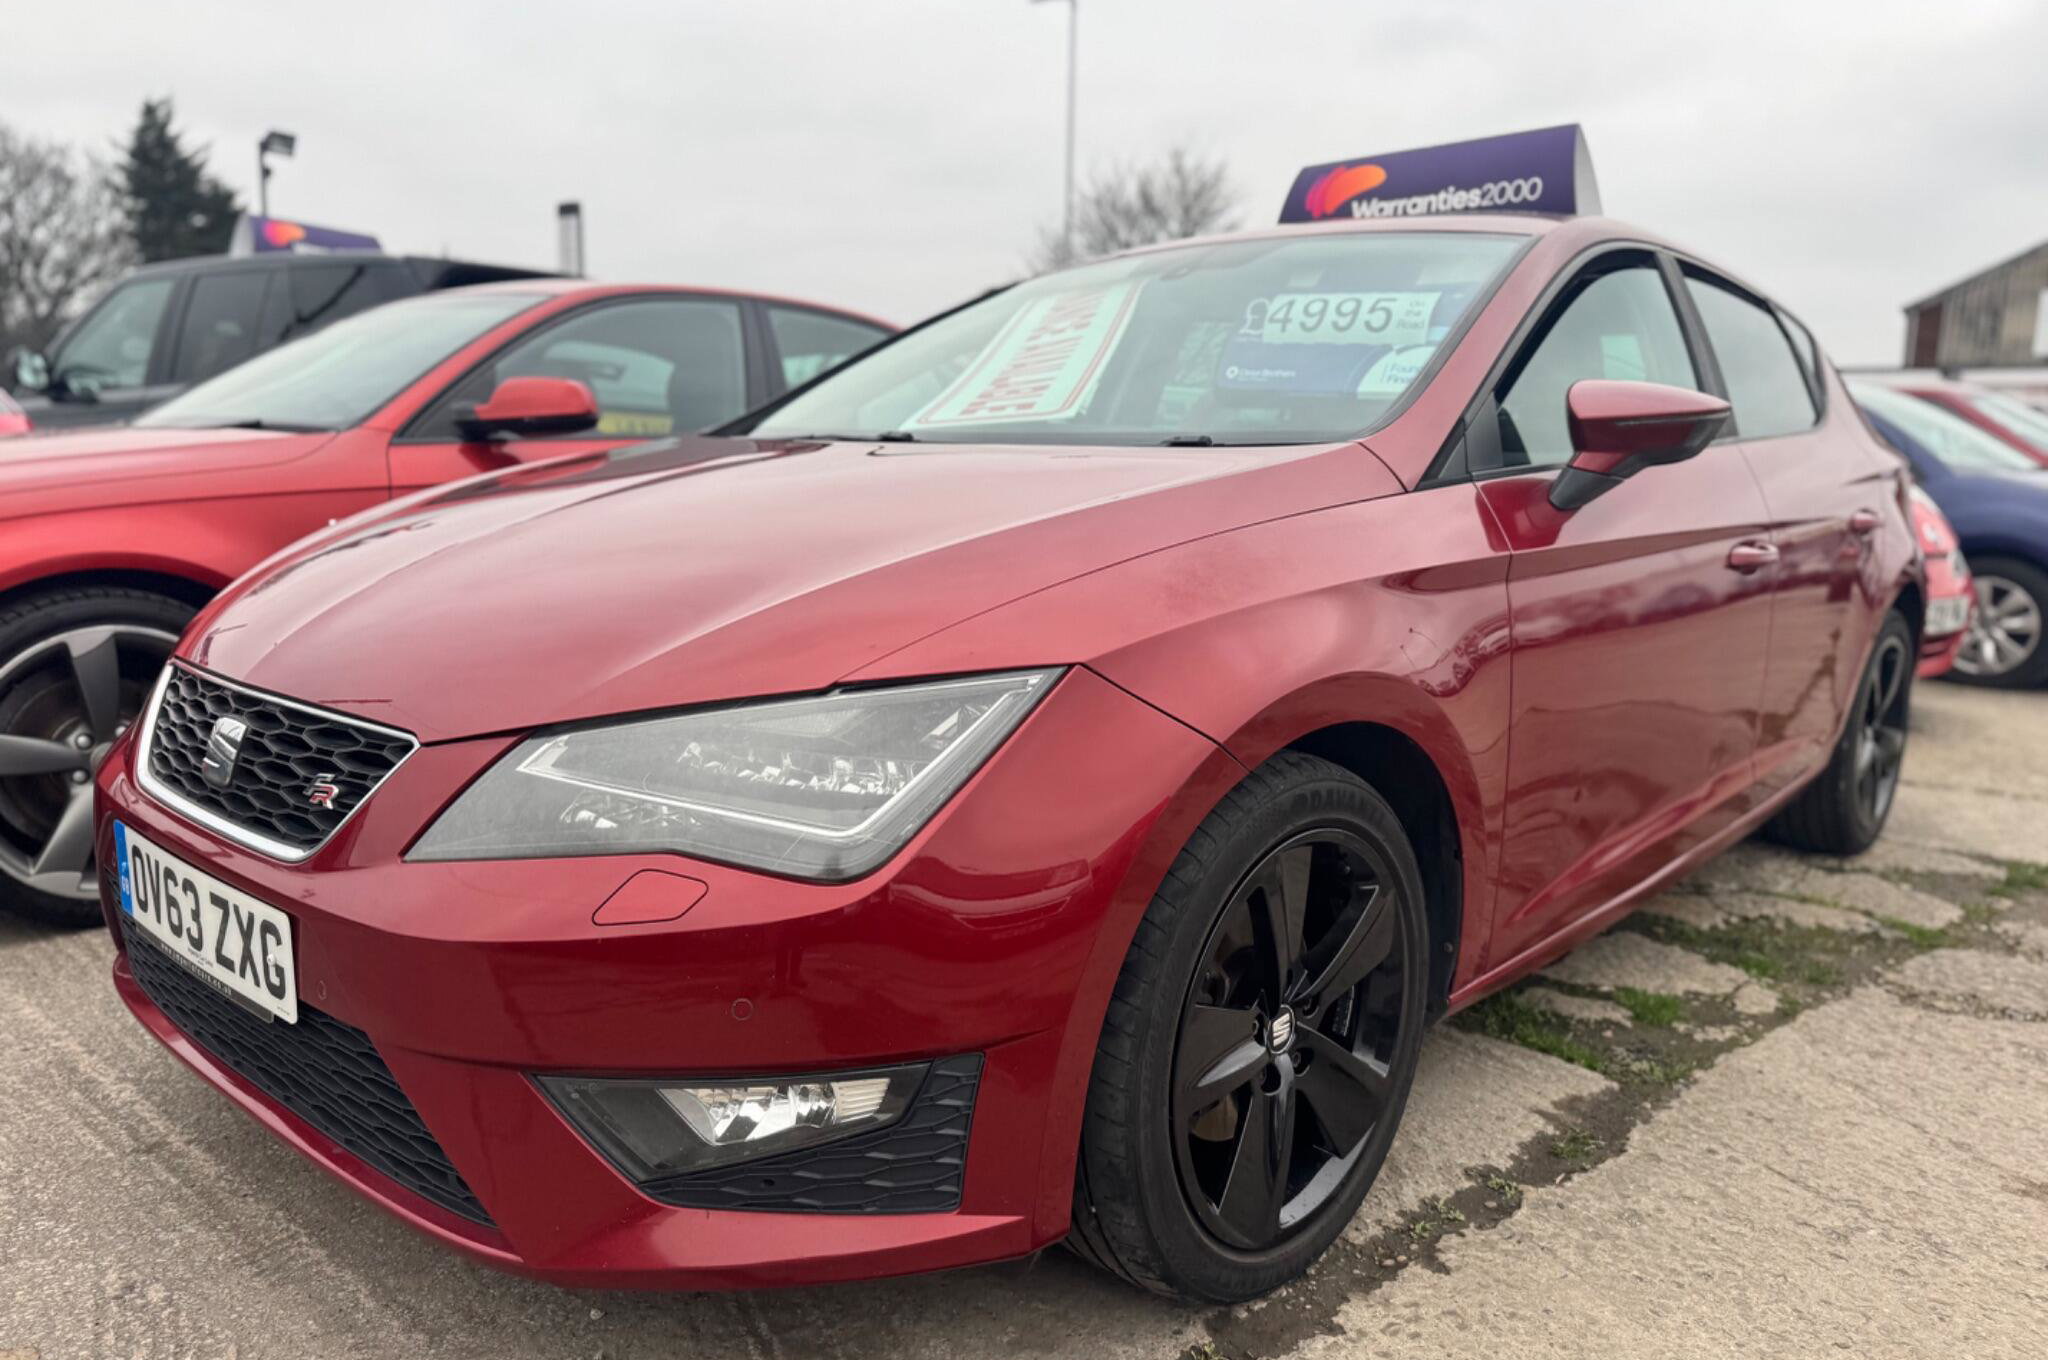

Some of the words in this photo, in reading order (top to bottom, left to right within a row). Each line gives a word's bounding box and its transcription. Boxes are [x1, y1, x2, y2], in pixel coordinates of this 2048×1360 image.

[1351, 177, 1543, 219] Warranties2000
[131, 843, 204, 952] OV63
[209, 890, 286, 1001] ZXG
